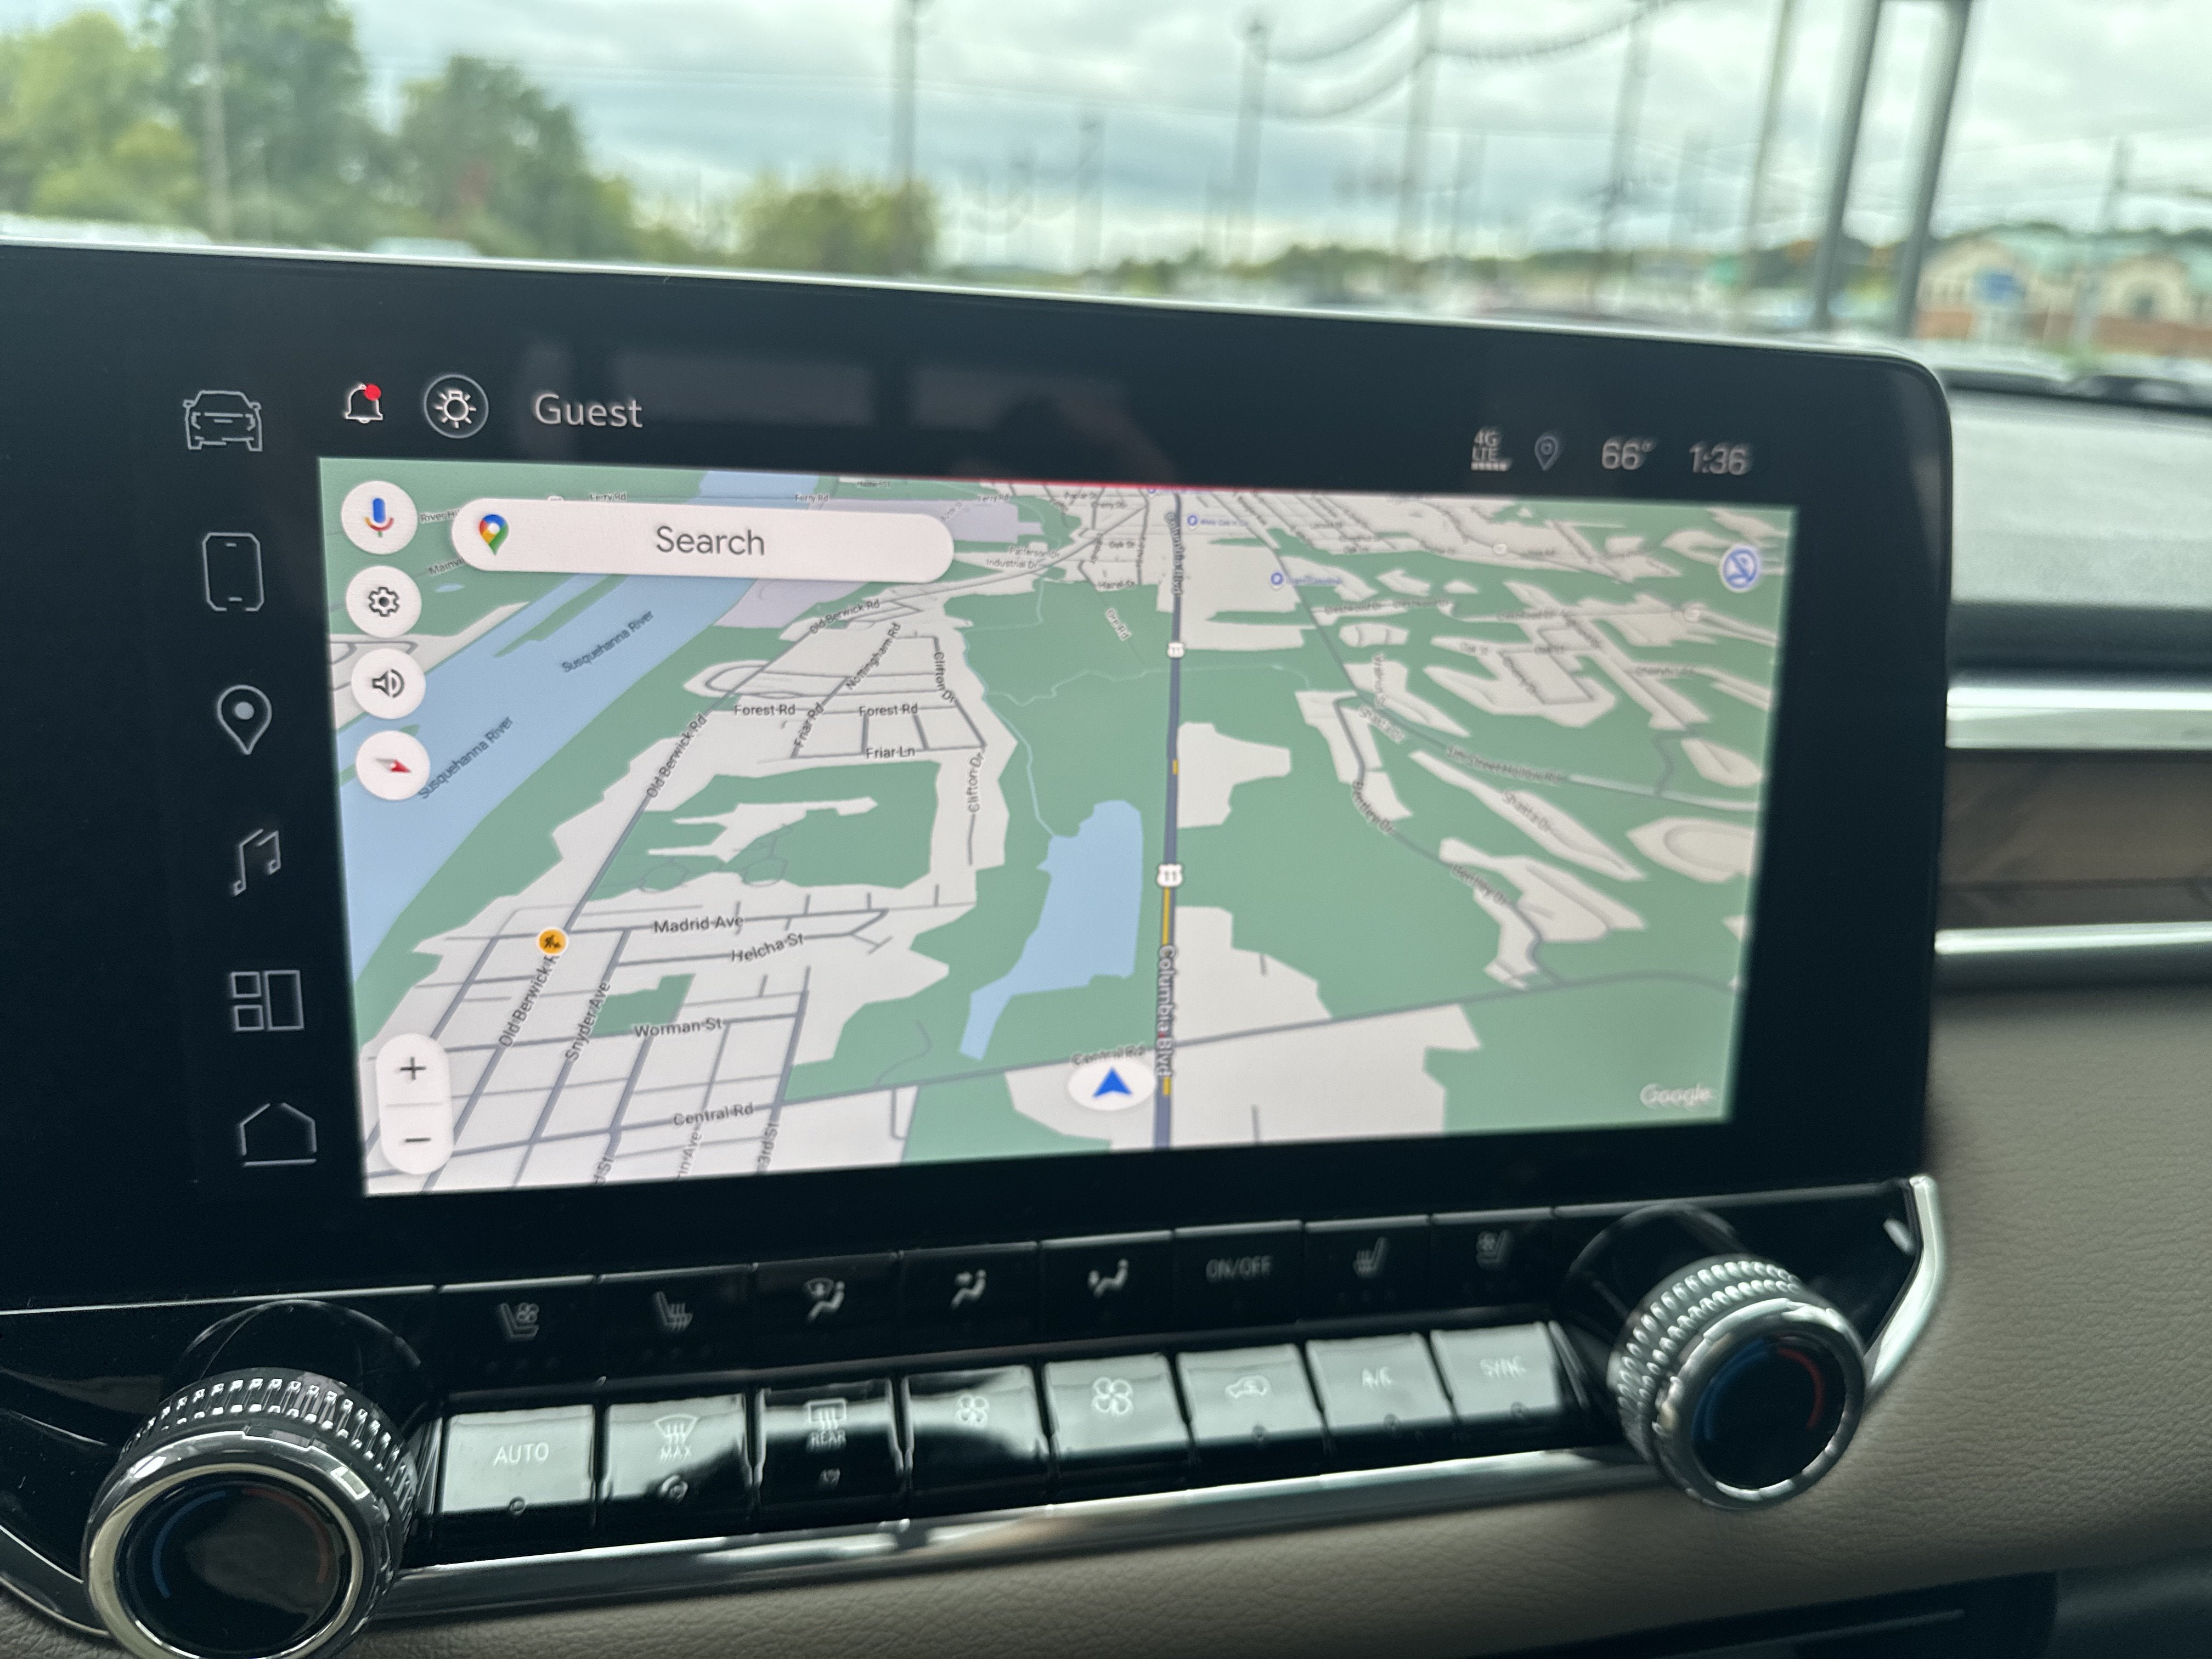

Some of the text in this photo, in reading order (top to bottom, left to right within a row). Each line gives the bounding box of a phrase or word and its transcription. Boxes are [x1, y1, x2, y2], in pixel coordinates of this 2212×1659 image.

[535, 392, 644, 429] Guest
[1474, 428, 1500, 447] 4G
[1471, 447, 1497, 462] LTE
[1601, 438, 1656, 470] 66°
[1689, 443, 1750, 476] 1:36
[613, 493, 626, 501] Rd
[795, 494, 816, 504] Ferry
[978, 494, 997, 503] Ferry
[420, 512, 445, 522] River
[657, 525, 766, 555] Search
[986, 558, 1039, 568] Industrial Dr
[809, 599, 881, 634] Old Berwick Rd
[561, 610, 654, 673] Susquehanna River
[845, 622, 901, 690] Nottingham Rd
[934, 651, 956, 703] Clifton Dr
[733, 704, 796, 716] Forest Rd
[859, 703, 918, 717] Forest Rd
[794, 702, 825, 748] Friar Rd
[417, 716, 514, 799] Susquehanna River
[646, 713, 707, 798] Old Berwick Rd
[865, 746, 916, 760] Friar Ln
[966, 752, 984, 813] Clifton Dr
[1163, 870, 1177, 882] 11
[653, 916, 744, 933] Madrid Ave
[731, 933, 804, 962] Helcha St
[498, 1022, 521, 1048] Old
[512, 966, 554, 1022] Berwick
[1155, 945, 1176, 1076] Columbia Blvd
[565, 982, 611, 1061] Snyder Ave
[634, 1018, 723, 1037] Worman St
[674, 1102, 754, 1126] Central Rd
[683, 1131, 702, 1159] Ave
[764, 1123, 778, 1141] St
[1206, 1255, 1272, 1282] ON/OFF
[493, 1443, 550, 1466] AUTO
[660, 1446, 693, 1461] MAX
